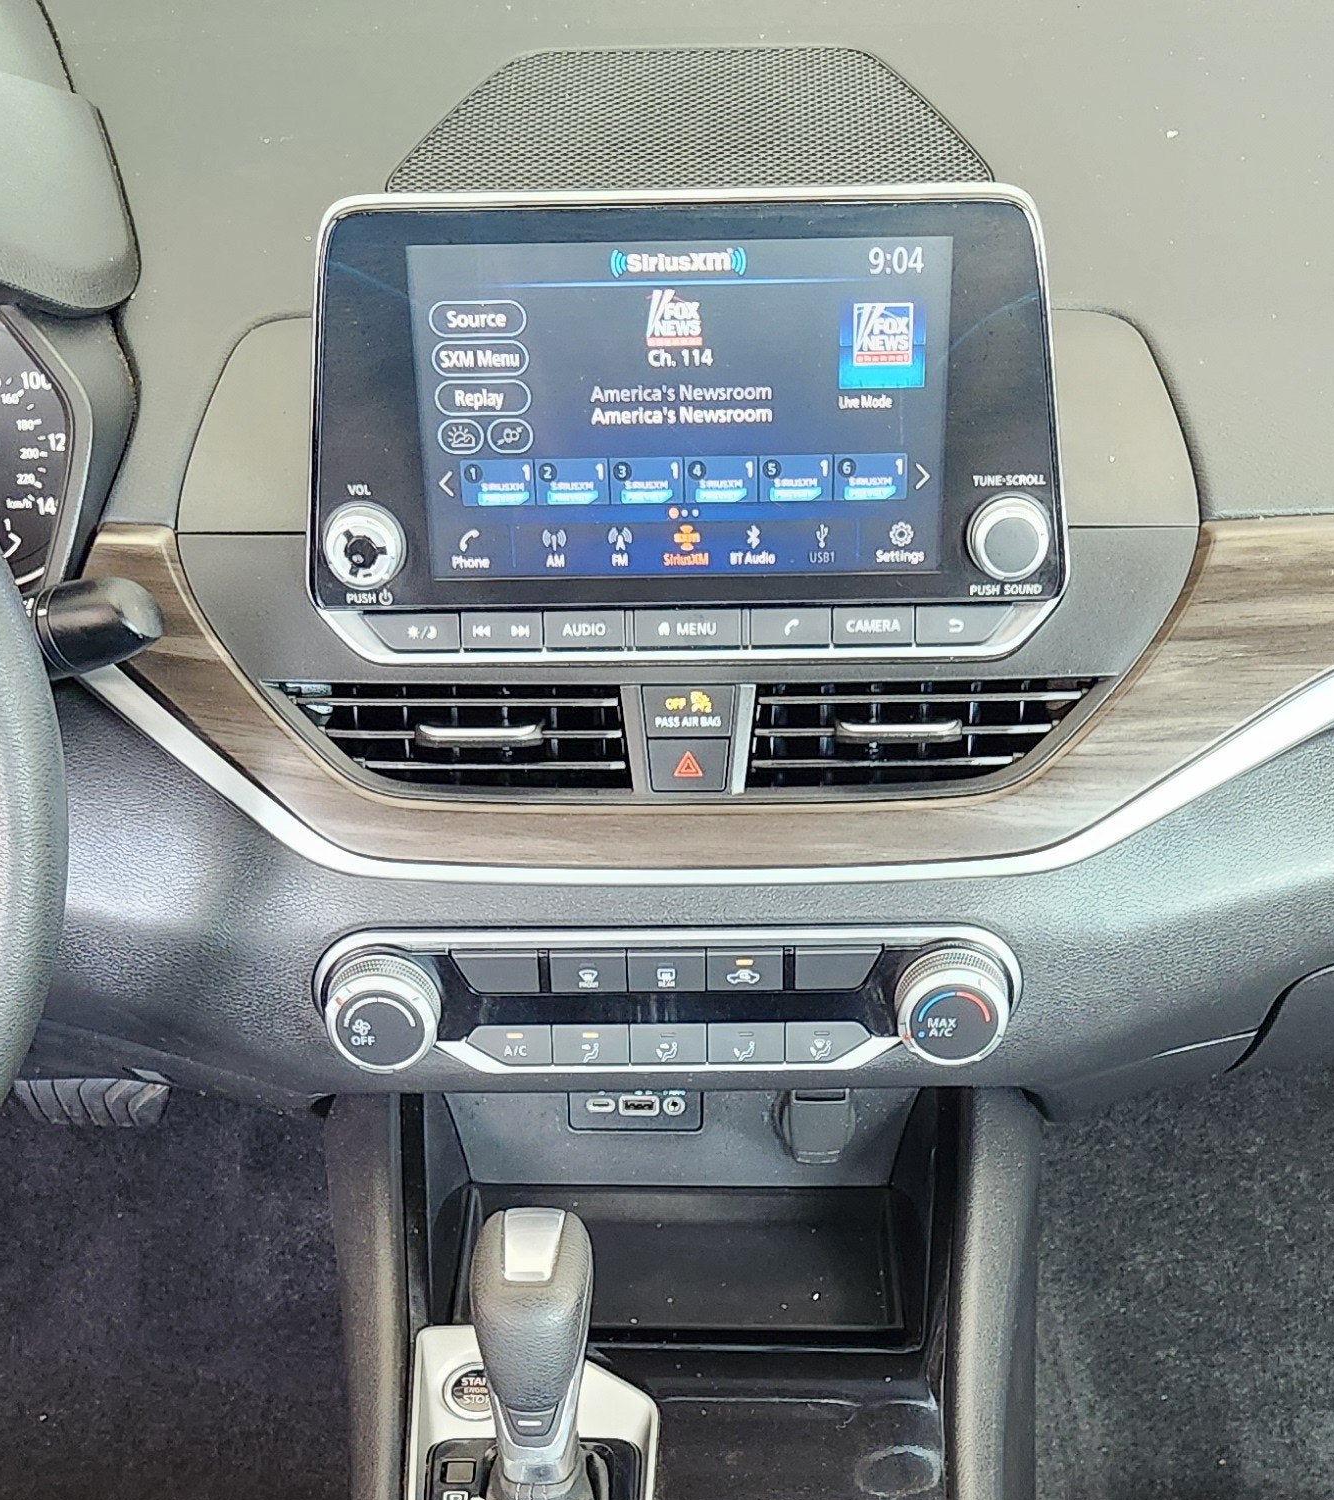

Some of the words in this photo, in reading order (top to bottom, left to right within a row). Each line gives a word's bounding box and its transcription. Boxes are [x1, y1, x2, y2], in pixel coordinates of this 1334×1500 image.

[868, 247, 924, 274] 9:04
[664, 301, 700, 320] FOX
[446, 310, 507, 328] Source
[872, 317, 909, 335] FOX
[654, 320, 702, 337] NEWS
[862, 335, 909, 352] NEWS
[440, 350, 474, 368] SXM
[477, 350, 519, 368] Menu
[648, 348, 677, 368] Ch.
[681, 348, 714, 368] 114
[454, 389, 505, 410] Replay
[591, 386, 674, 402] America's
[679, 384, 772, 401] Newsroom
[861, 394, 893, 409] Mode
[592, 407, 676, 425] America's
[680, 405, 773, 423] Newsroom
[48, 433, 66, 452] 12
[522, 464, 530, 481] 1
[595, 463, 604, 480] 1
[671, 461, 678, 479] 1
[745, 460, 753, 478] 1
[820, 459, 828, 477] 1
[895, 458, 903, 475] 1
[347, 484, 371, 497] VOL
[36, 497, 57, 515] 14
[452, 555, 490, 569] Phone
[546, 555, 565, 568] AM
[611, 555, 629, 567] FM
[745, 552, 776, 565] Audio
[809, 552, 835, 563] USB1
[876, 550, 925, 566] Settings
[969, 584, 1001, 596] PUSH
[1004, 583, 1043, 596] SOUND
[346, 592, 377, 605] PUSH
[562, 622, 606, 637] AUDIO
[676, 622, 717, 636] MENU
[846, 619, 901, 633] CAMERA
[654, 716, 680, 728] PASS
[681, 716, 699, 728] AIR
[700, 715, 722, 728] BAG
[927, 1017, 957, 1029] MAX
[350, 1035, 376, 1047] OFF
[928, 1028, 954, 1038] A/C
[504, 1045, 528, 1057] A/C
[461, 1377, 486, 1387] STA
